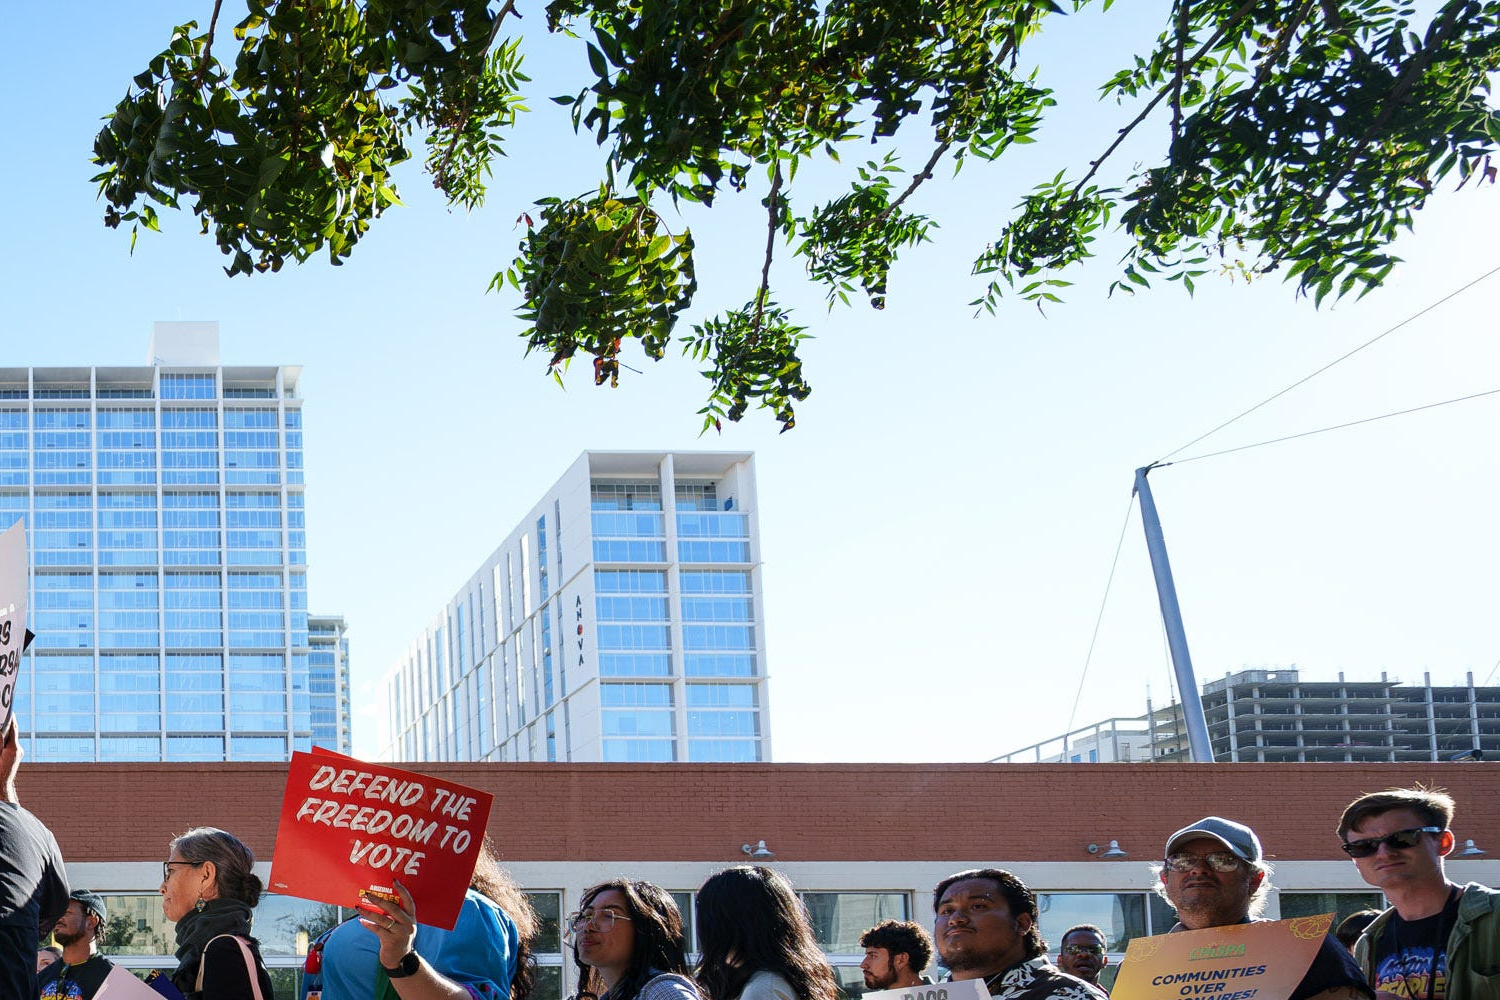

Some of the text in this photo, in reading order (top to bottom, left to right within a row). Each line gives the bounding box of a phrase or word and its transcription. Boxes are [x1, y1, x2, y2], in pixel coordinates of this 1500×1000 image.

[576, 594, 584, 667] ANOVA
[308, 765, 477, 821] DEFEND THE
[296, 797, 471, 854] FREEDOM TO
[349, 839, 426, 876] VOTE
[1152, 964, 1267, 986] COMMUNITIES
[1179, 982, 1226, 996] OVER
